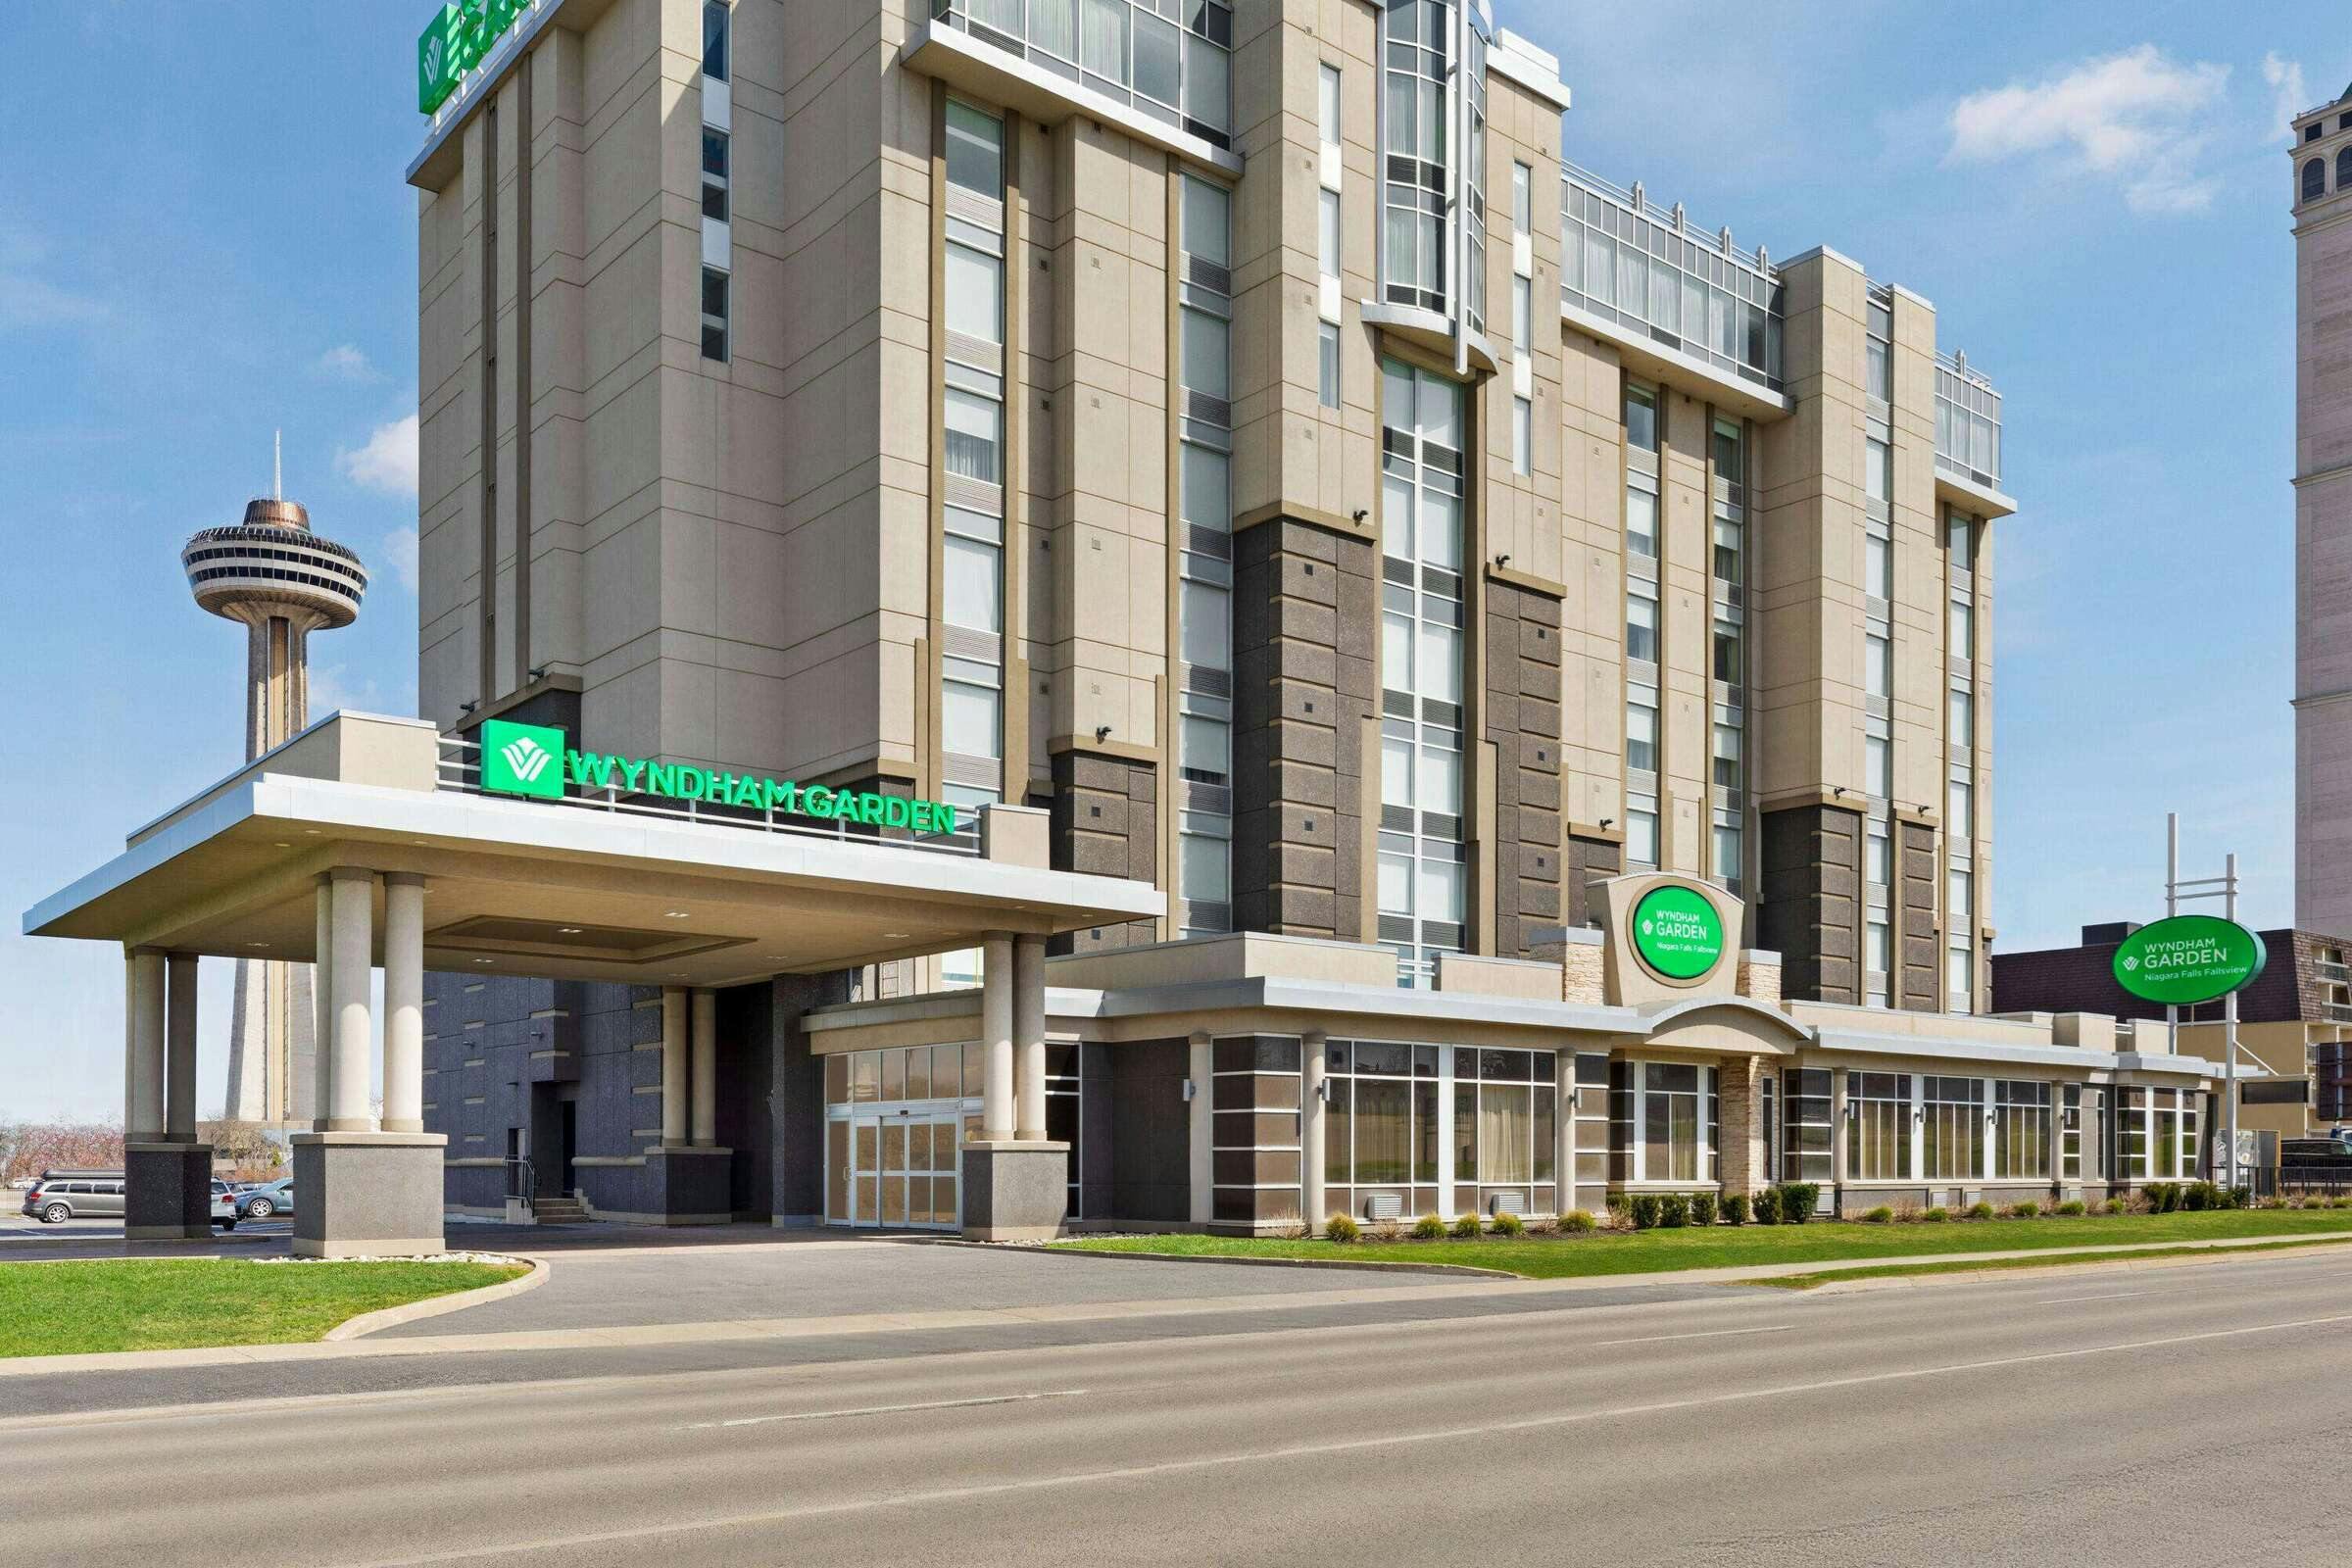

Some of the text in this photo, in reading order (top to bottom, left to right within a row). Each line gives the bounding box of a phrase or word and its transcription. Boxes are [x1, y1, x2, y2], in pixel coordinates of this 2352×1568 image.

[566, 749, 956, 836] WYNDHAM GARDEN
[1655, 909, 1700, 924] WYNDHAM
[1656, 921, 1707, 941] GARDEN
[2144, 938, 2216, 954] WYNDHAM
[2144, 948, 2227, 968] GARDEN
[2144, 966, 2247, 982] Niagara Falls Fallsview
